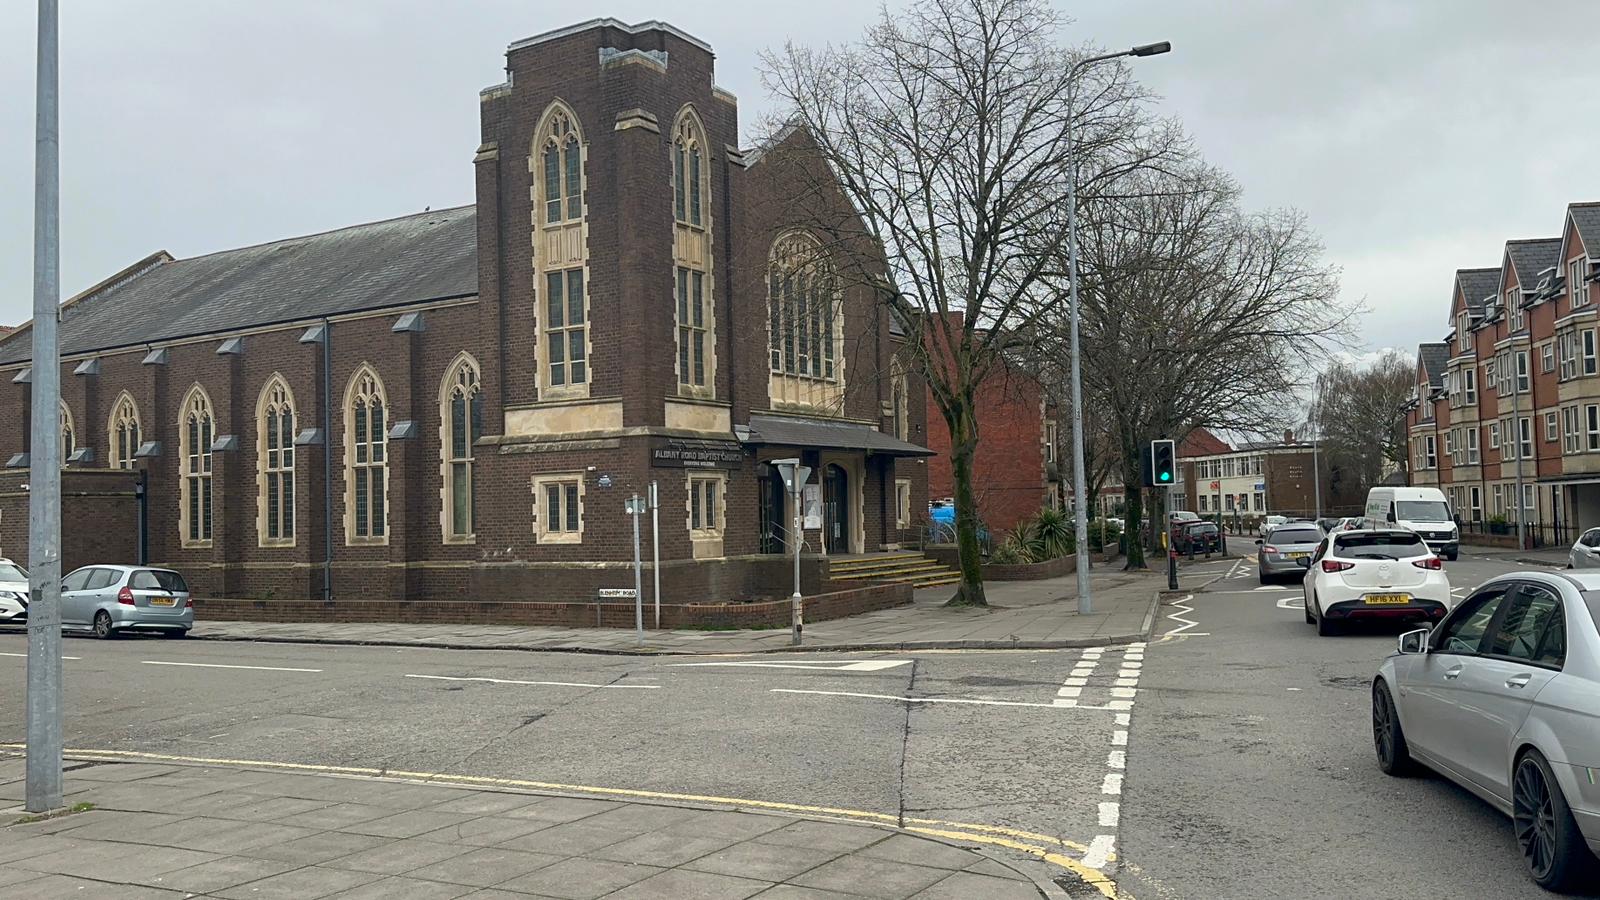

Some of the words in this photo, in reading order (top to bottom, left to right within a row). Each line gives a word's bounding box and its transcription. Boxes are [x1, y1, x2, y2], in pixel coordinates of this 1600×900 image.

[655, 449, 680, 459] ALBANY
[681, 451, 697, 460] ROAD
[698, 451, 721, 461] BAPTIST
[1369, 595, 1388, 603] HF16
[1388, 595, 1404, 603] XXL
